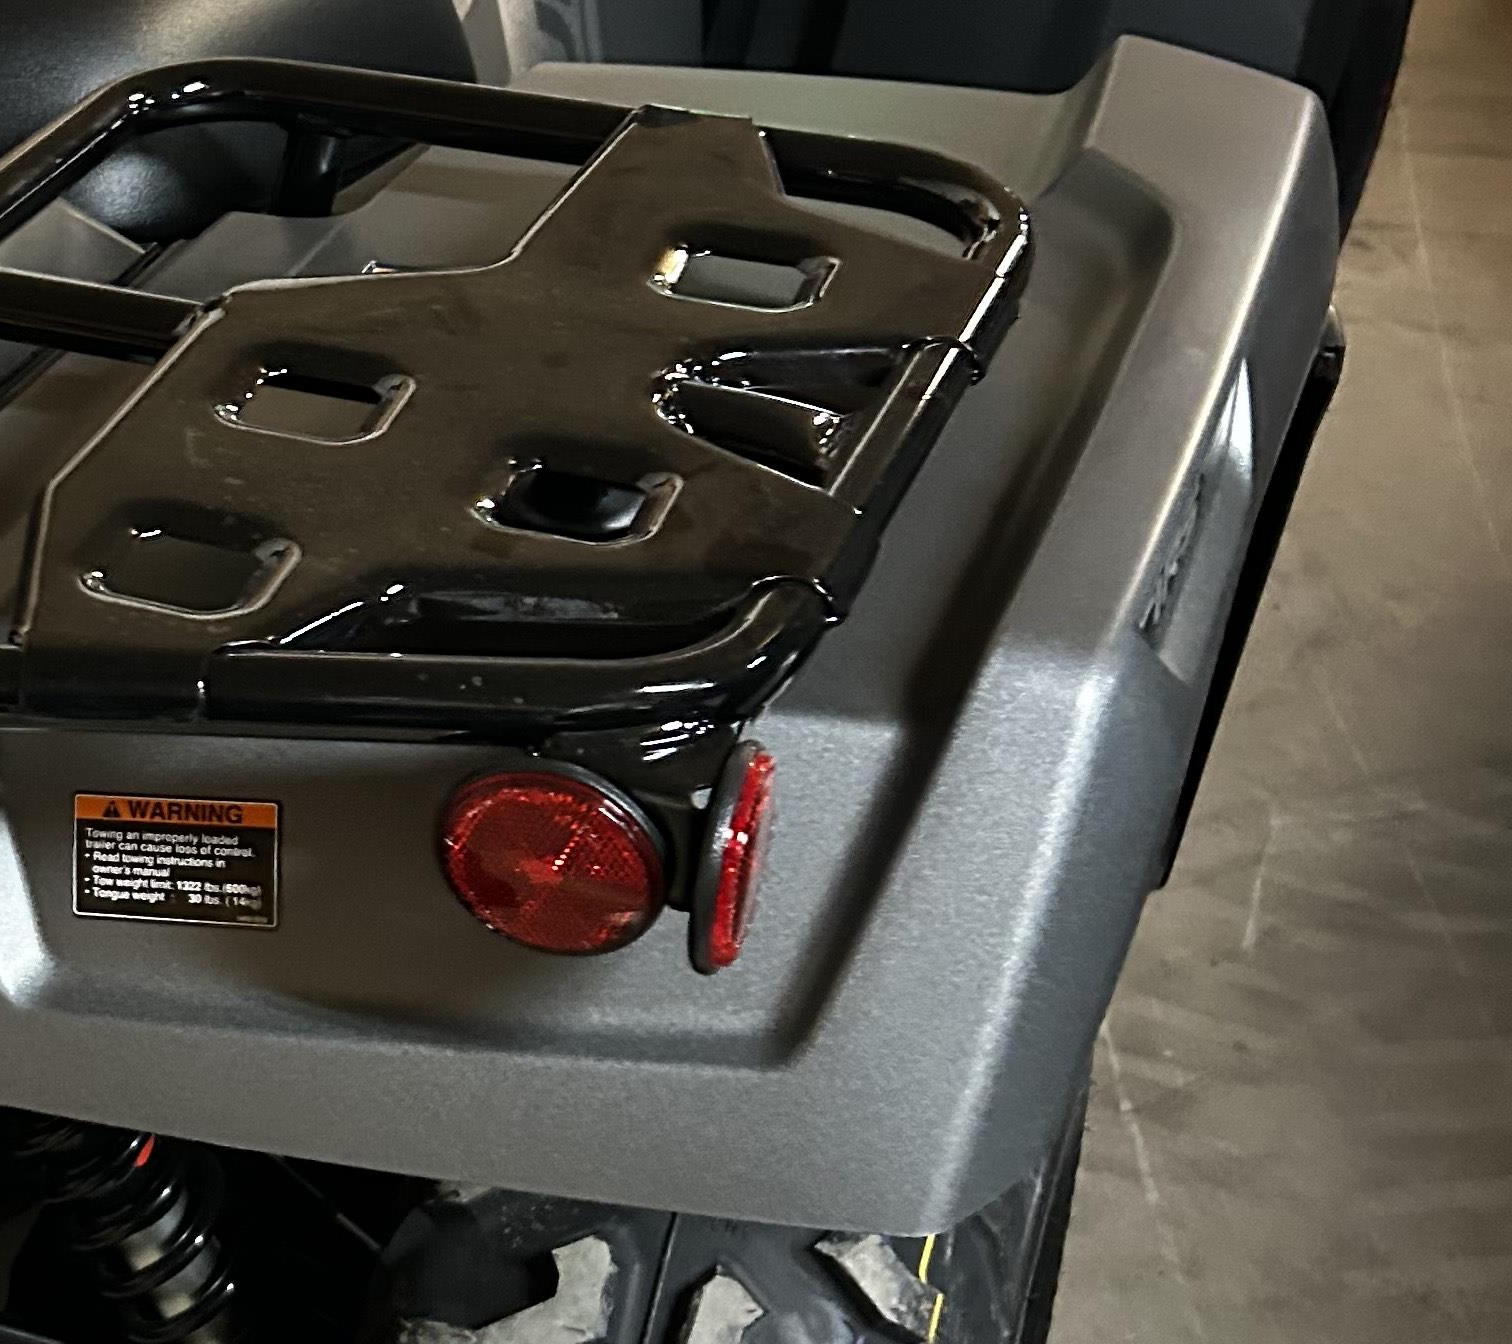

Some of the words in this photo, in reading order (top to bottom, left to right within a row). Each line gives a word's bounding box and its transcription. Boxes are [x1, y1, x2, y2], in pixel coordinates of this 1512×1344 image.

[127, 800, 244, 824] WARNING
[85, 827, 124, 842] Towing
[126, 831, 140, 840] an
[142, 832, 198, 846] improperly
[201, 833, 239, 846] loaded
[85, 839, 117, 850] trailer
[118, 842, 138, 851] can
[140, 843, 172, 854] cause
[175, 844, 198, 855] loss
[200, 845, 211, 855] of
[93, 850, 120, 863] Read
[121, 853, 155, 867] towing
[156, 856, 214, 868] instructions
[215, 858, 227, 868] in
[92, 864, 131, 876] owner's
[132, 867, 170, 877] manual
[93, 874, 114, 887] Tow
[115, 877, 149, 890] weight
[92, 886, 130, 901] Tongue
[131, 891, 166, 904] weight
[188, 893, 202, 904] 30
